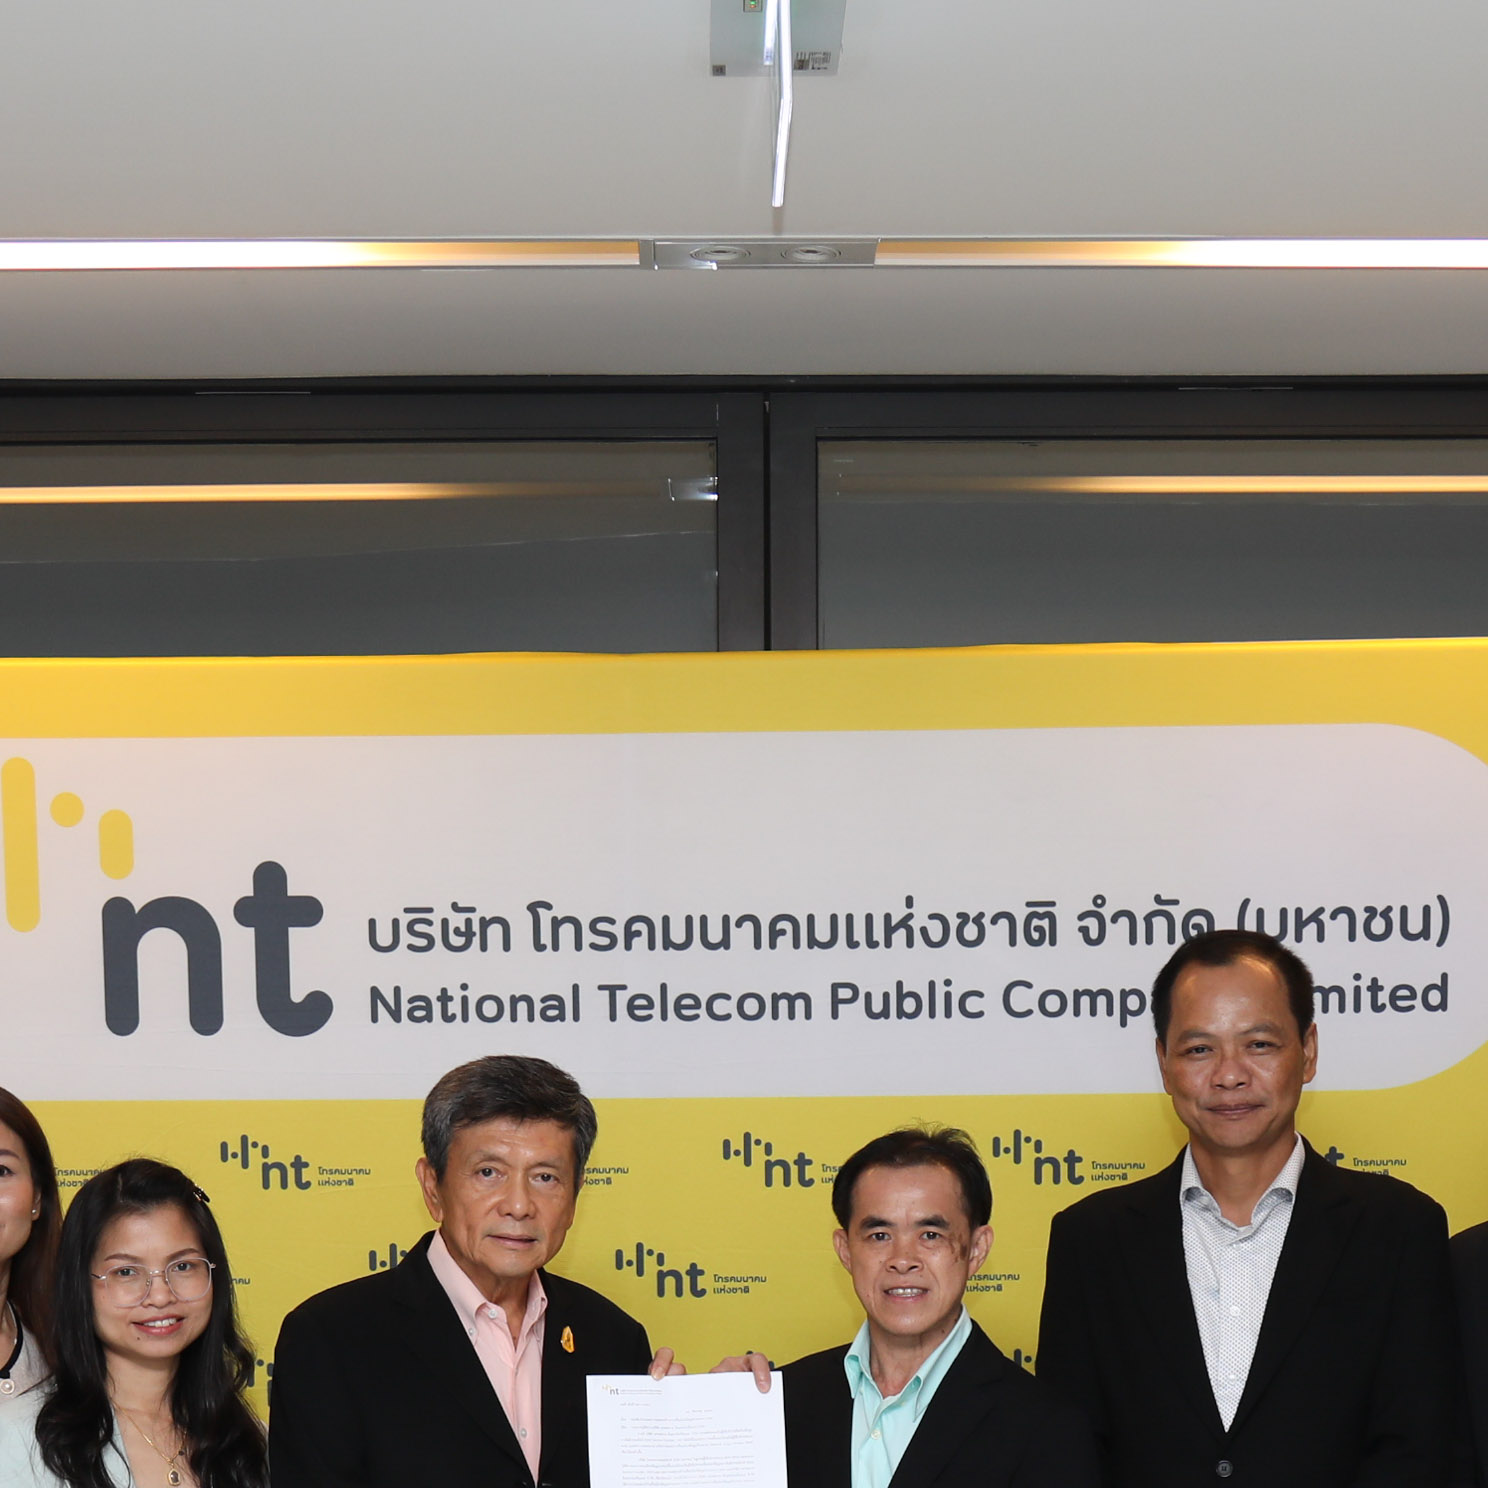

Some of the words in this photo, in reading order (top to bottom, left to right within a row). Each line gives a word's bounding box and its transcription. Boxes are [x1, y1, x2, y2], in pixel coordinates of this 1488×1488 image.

[368, 901, 512, 953] บริษัท
[526, 894, 1058, 953] โทรคมนาคมแห่งชาติ
[1077, 894, 1216, 947] จำกัด
[102, 860, 334, 1037] nt
[369, 982, 581, 1024] National
[598, 981, 813, 1023] Telecom
[830, 978, 986, 1021] Public
[1001, 979, 1155, 1029] Comp
[1311, 972, 1449, 1015] mited
[261, 1154, 312, 1190] nt
[317, 1166, 372, 1176] โทรคมนาคม
[764, 1151, 816, 1188] nt
[1033, 1149, 1085, 1186] nt
[1091, 1160, 1146, 1171] โทรคมนาคม
[1353, 1157, 1408, 1167] โทรคมนาคม
[656, 1262, 707, 1299] nt
[713, 1273, 768, 1283] โทรคมนาคม
